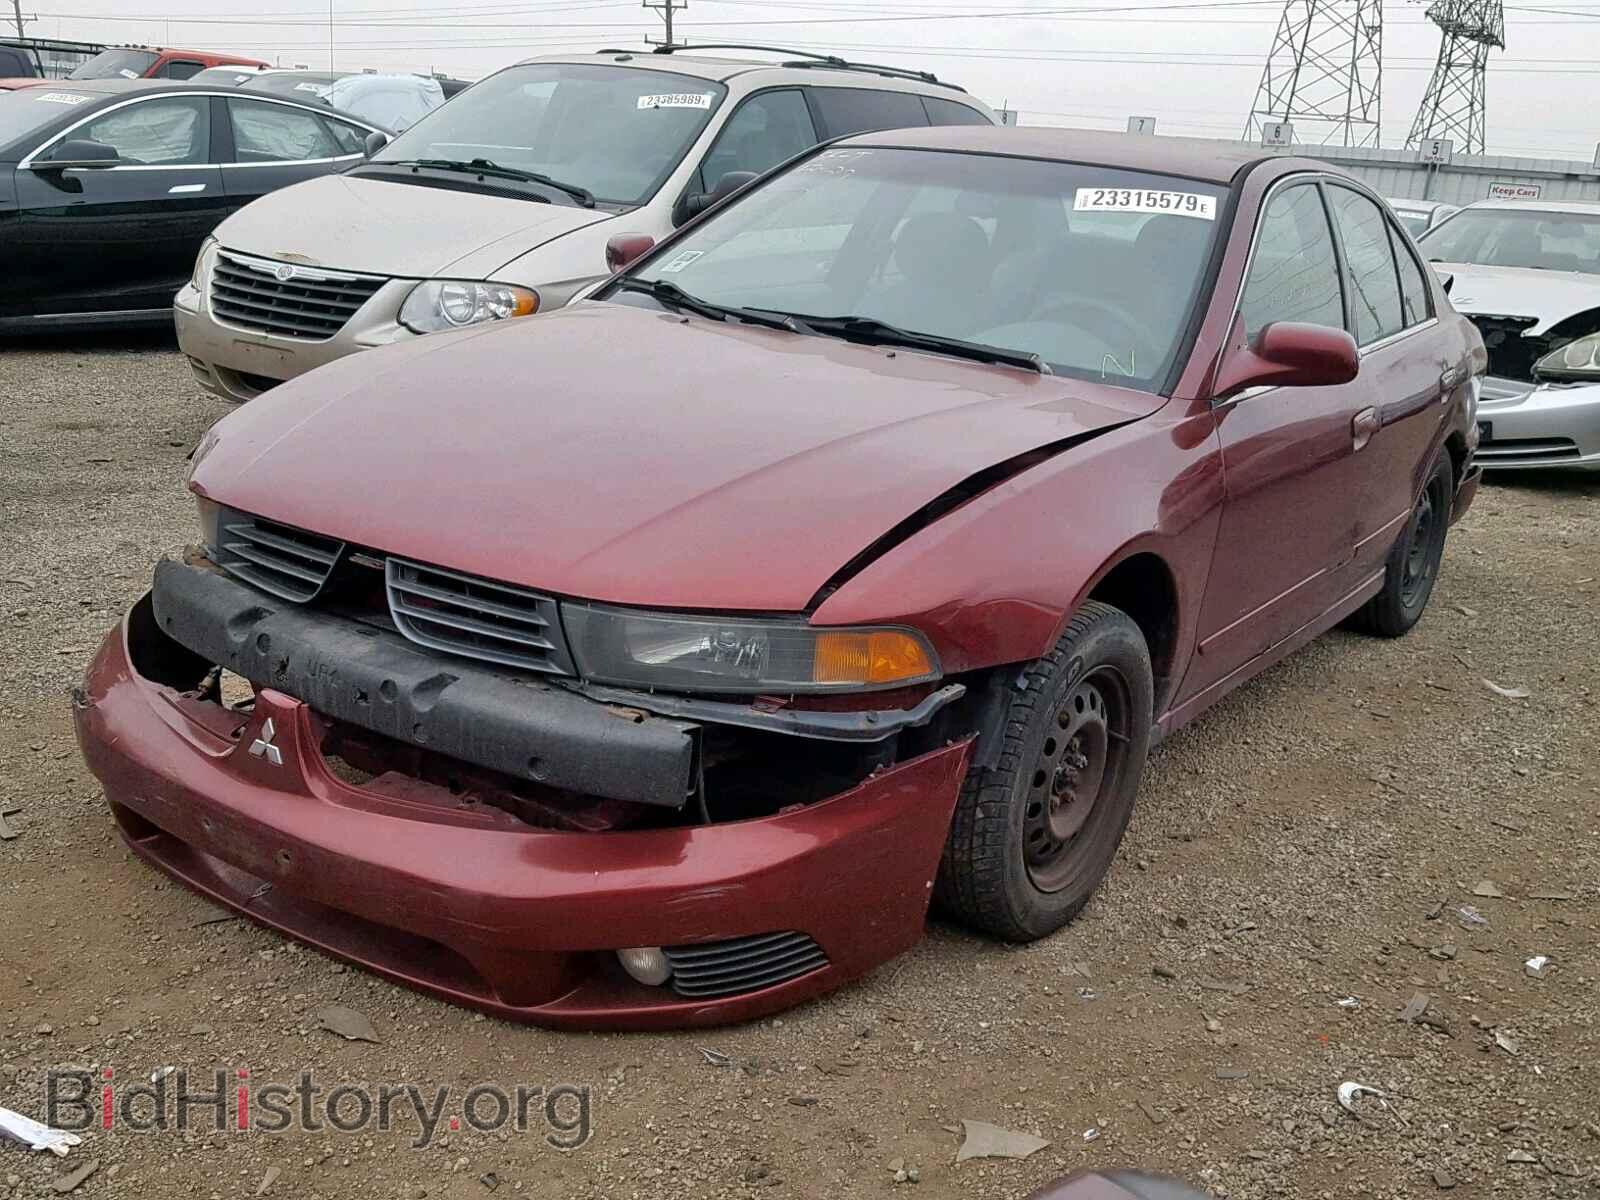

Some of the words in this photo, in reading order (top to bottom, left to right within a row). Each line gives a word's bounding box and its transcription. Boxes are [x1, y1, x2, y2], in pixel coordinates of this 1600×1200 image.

[1138, 119, 1145, 132] 7
[1274, 125, 1281, 139] 6
[1432, 142, 1440, 155] 5
[1492, 185, 1515, 196] Keep
[1516, 187, 1537, 197] Cars
[1092, 189, 1198, 212] 23315579
